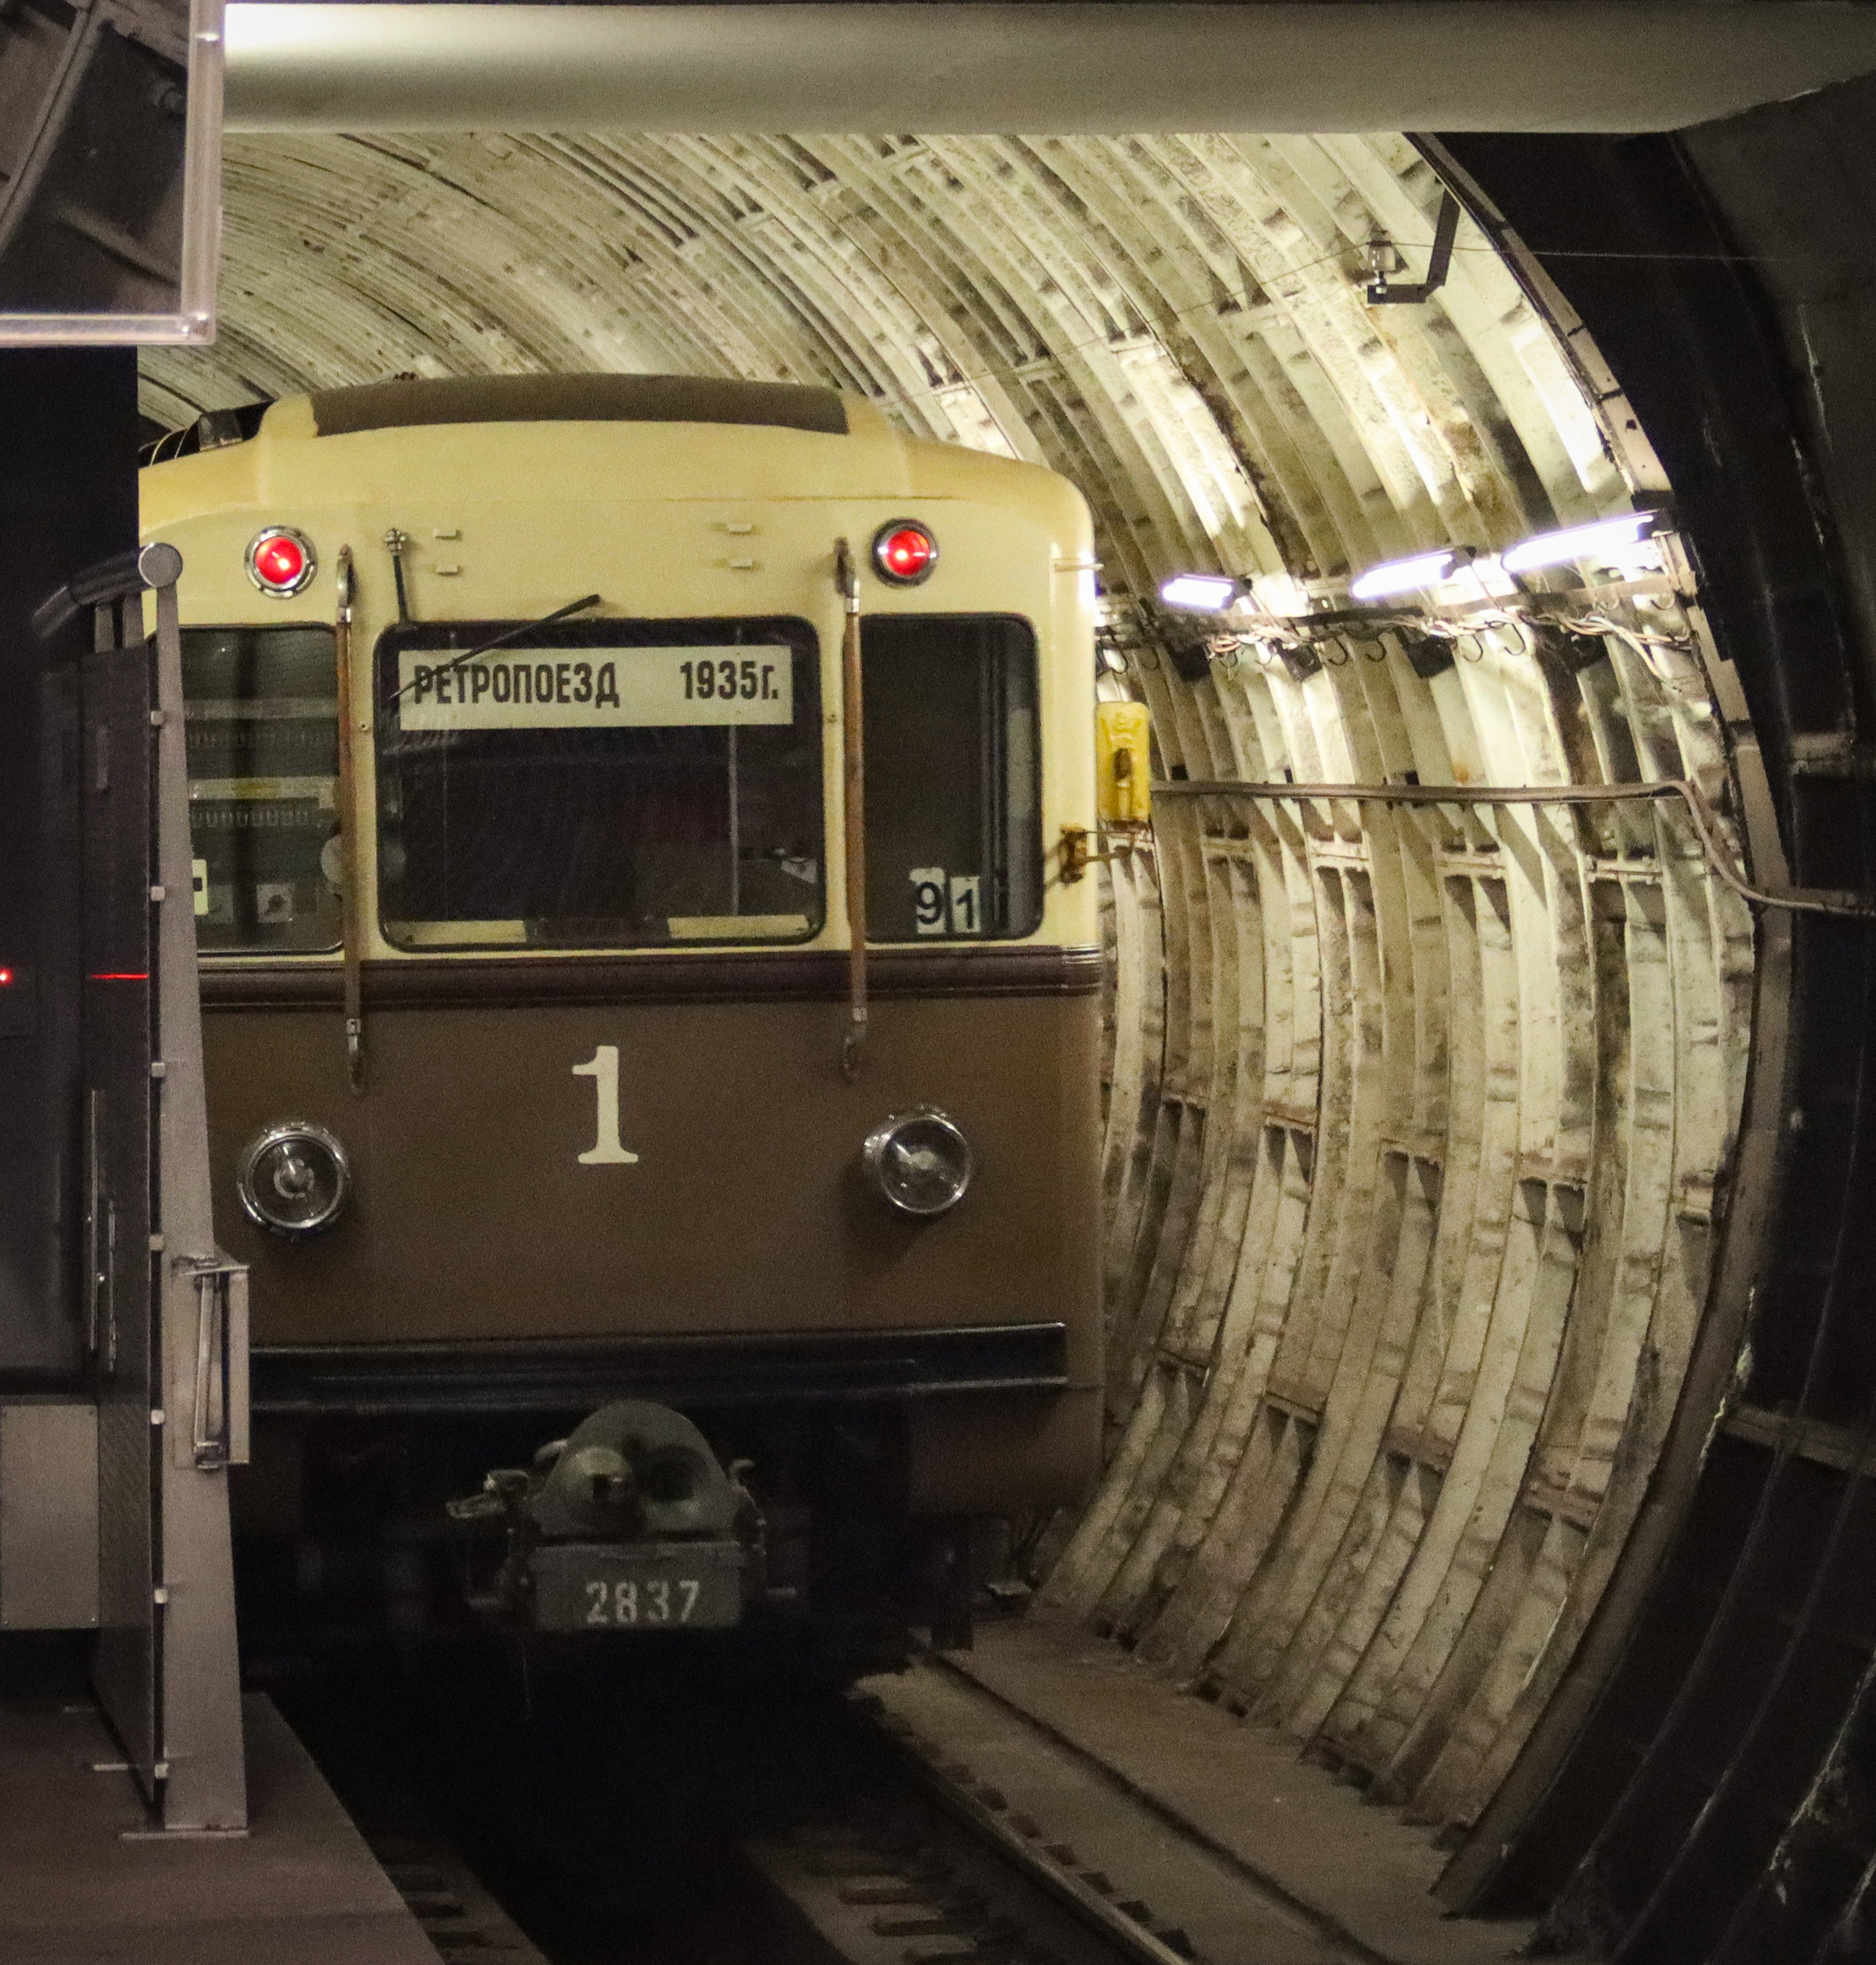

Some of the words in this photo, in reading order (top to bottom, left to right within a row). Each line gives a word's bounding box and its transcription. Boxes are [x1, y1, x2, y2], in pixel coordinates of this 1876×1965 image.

[414, 662, 620, 708] РЕТРОПОЕЗД
[572, 1045, 639, 1164] 1
[586, 1580, 699, 1624] 2837
